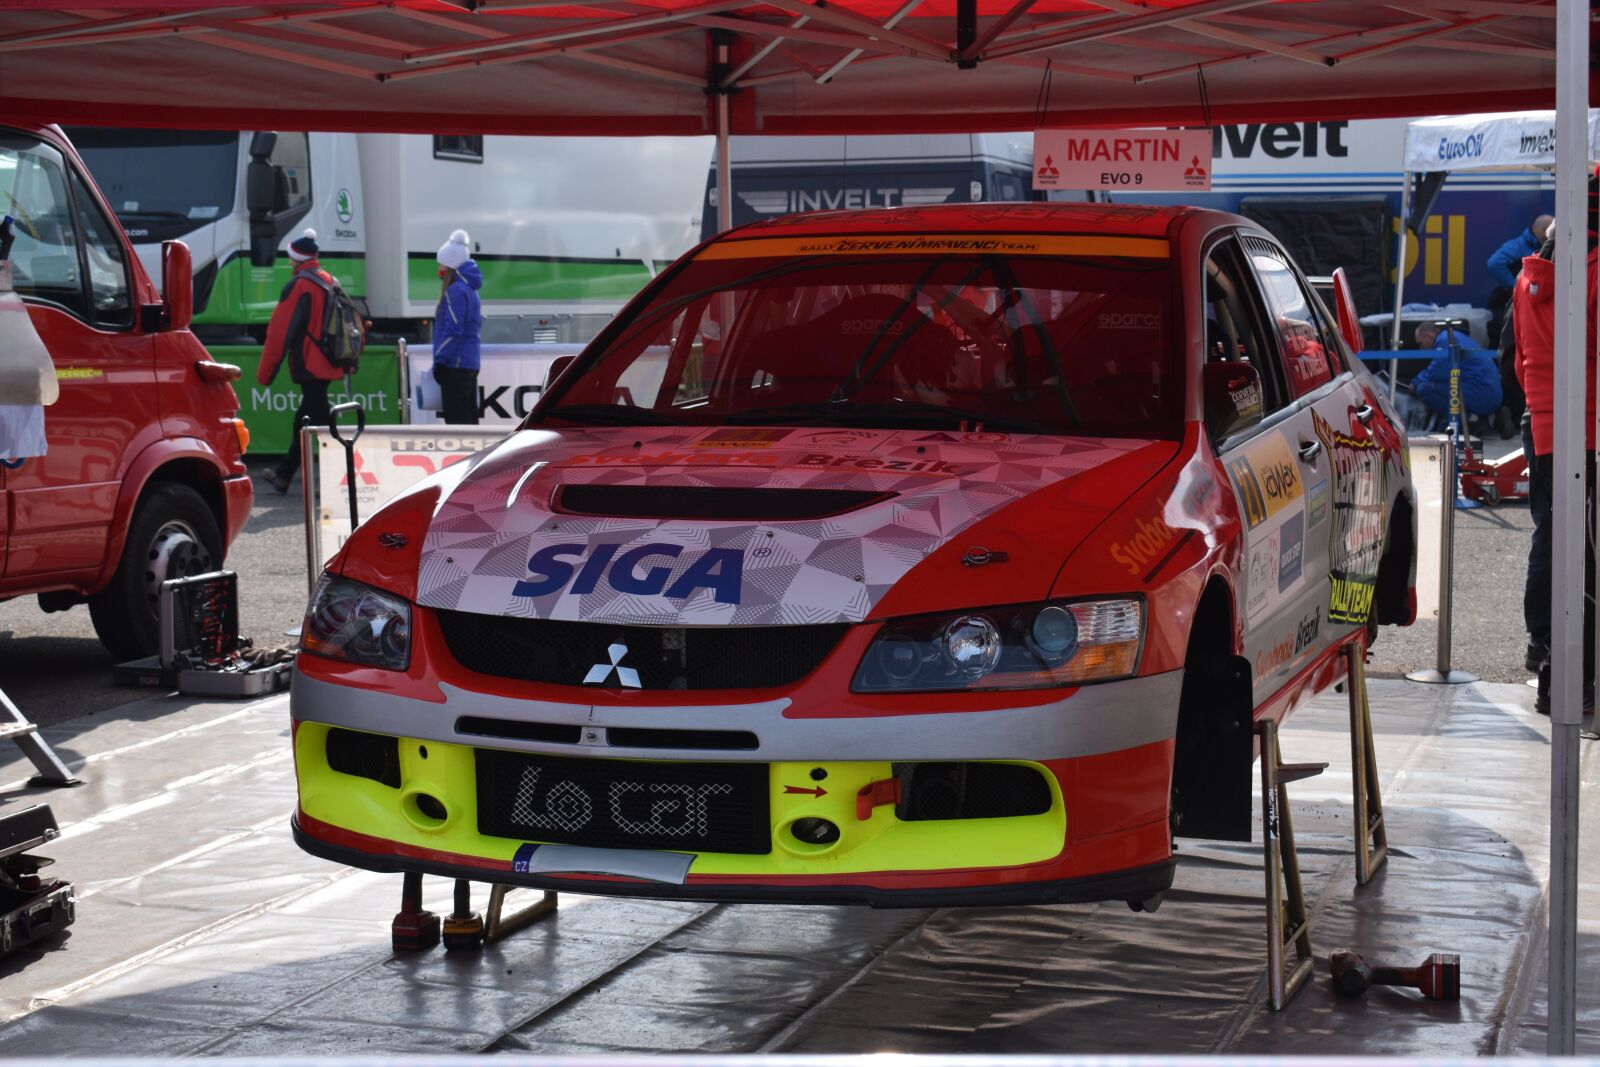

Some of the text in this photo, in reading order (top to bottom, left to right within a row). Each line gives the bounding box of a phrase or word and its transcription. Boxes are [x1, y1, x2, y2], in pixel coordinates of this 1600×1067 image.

[1067, 138, 1180, 162] MARTIN
[1212, 121, 1349, 159] velt
[1438, 133, 1484, 161] EuroOil
[1100, 173, 1143, 185] EVO 9
[790, 188, 899, 213] INVELT
[335, 228, 357, 238] ŠKODA
[799, 244, 834, 252] RALLY
[1001, 243, 1037, 251] TEAM
[1449, 368, 1460, 415] EuroOil
[511, 542, 746, 605] SIGA
[514, 860, 529, 873] CZ
